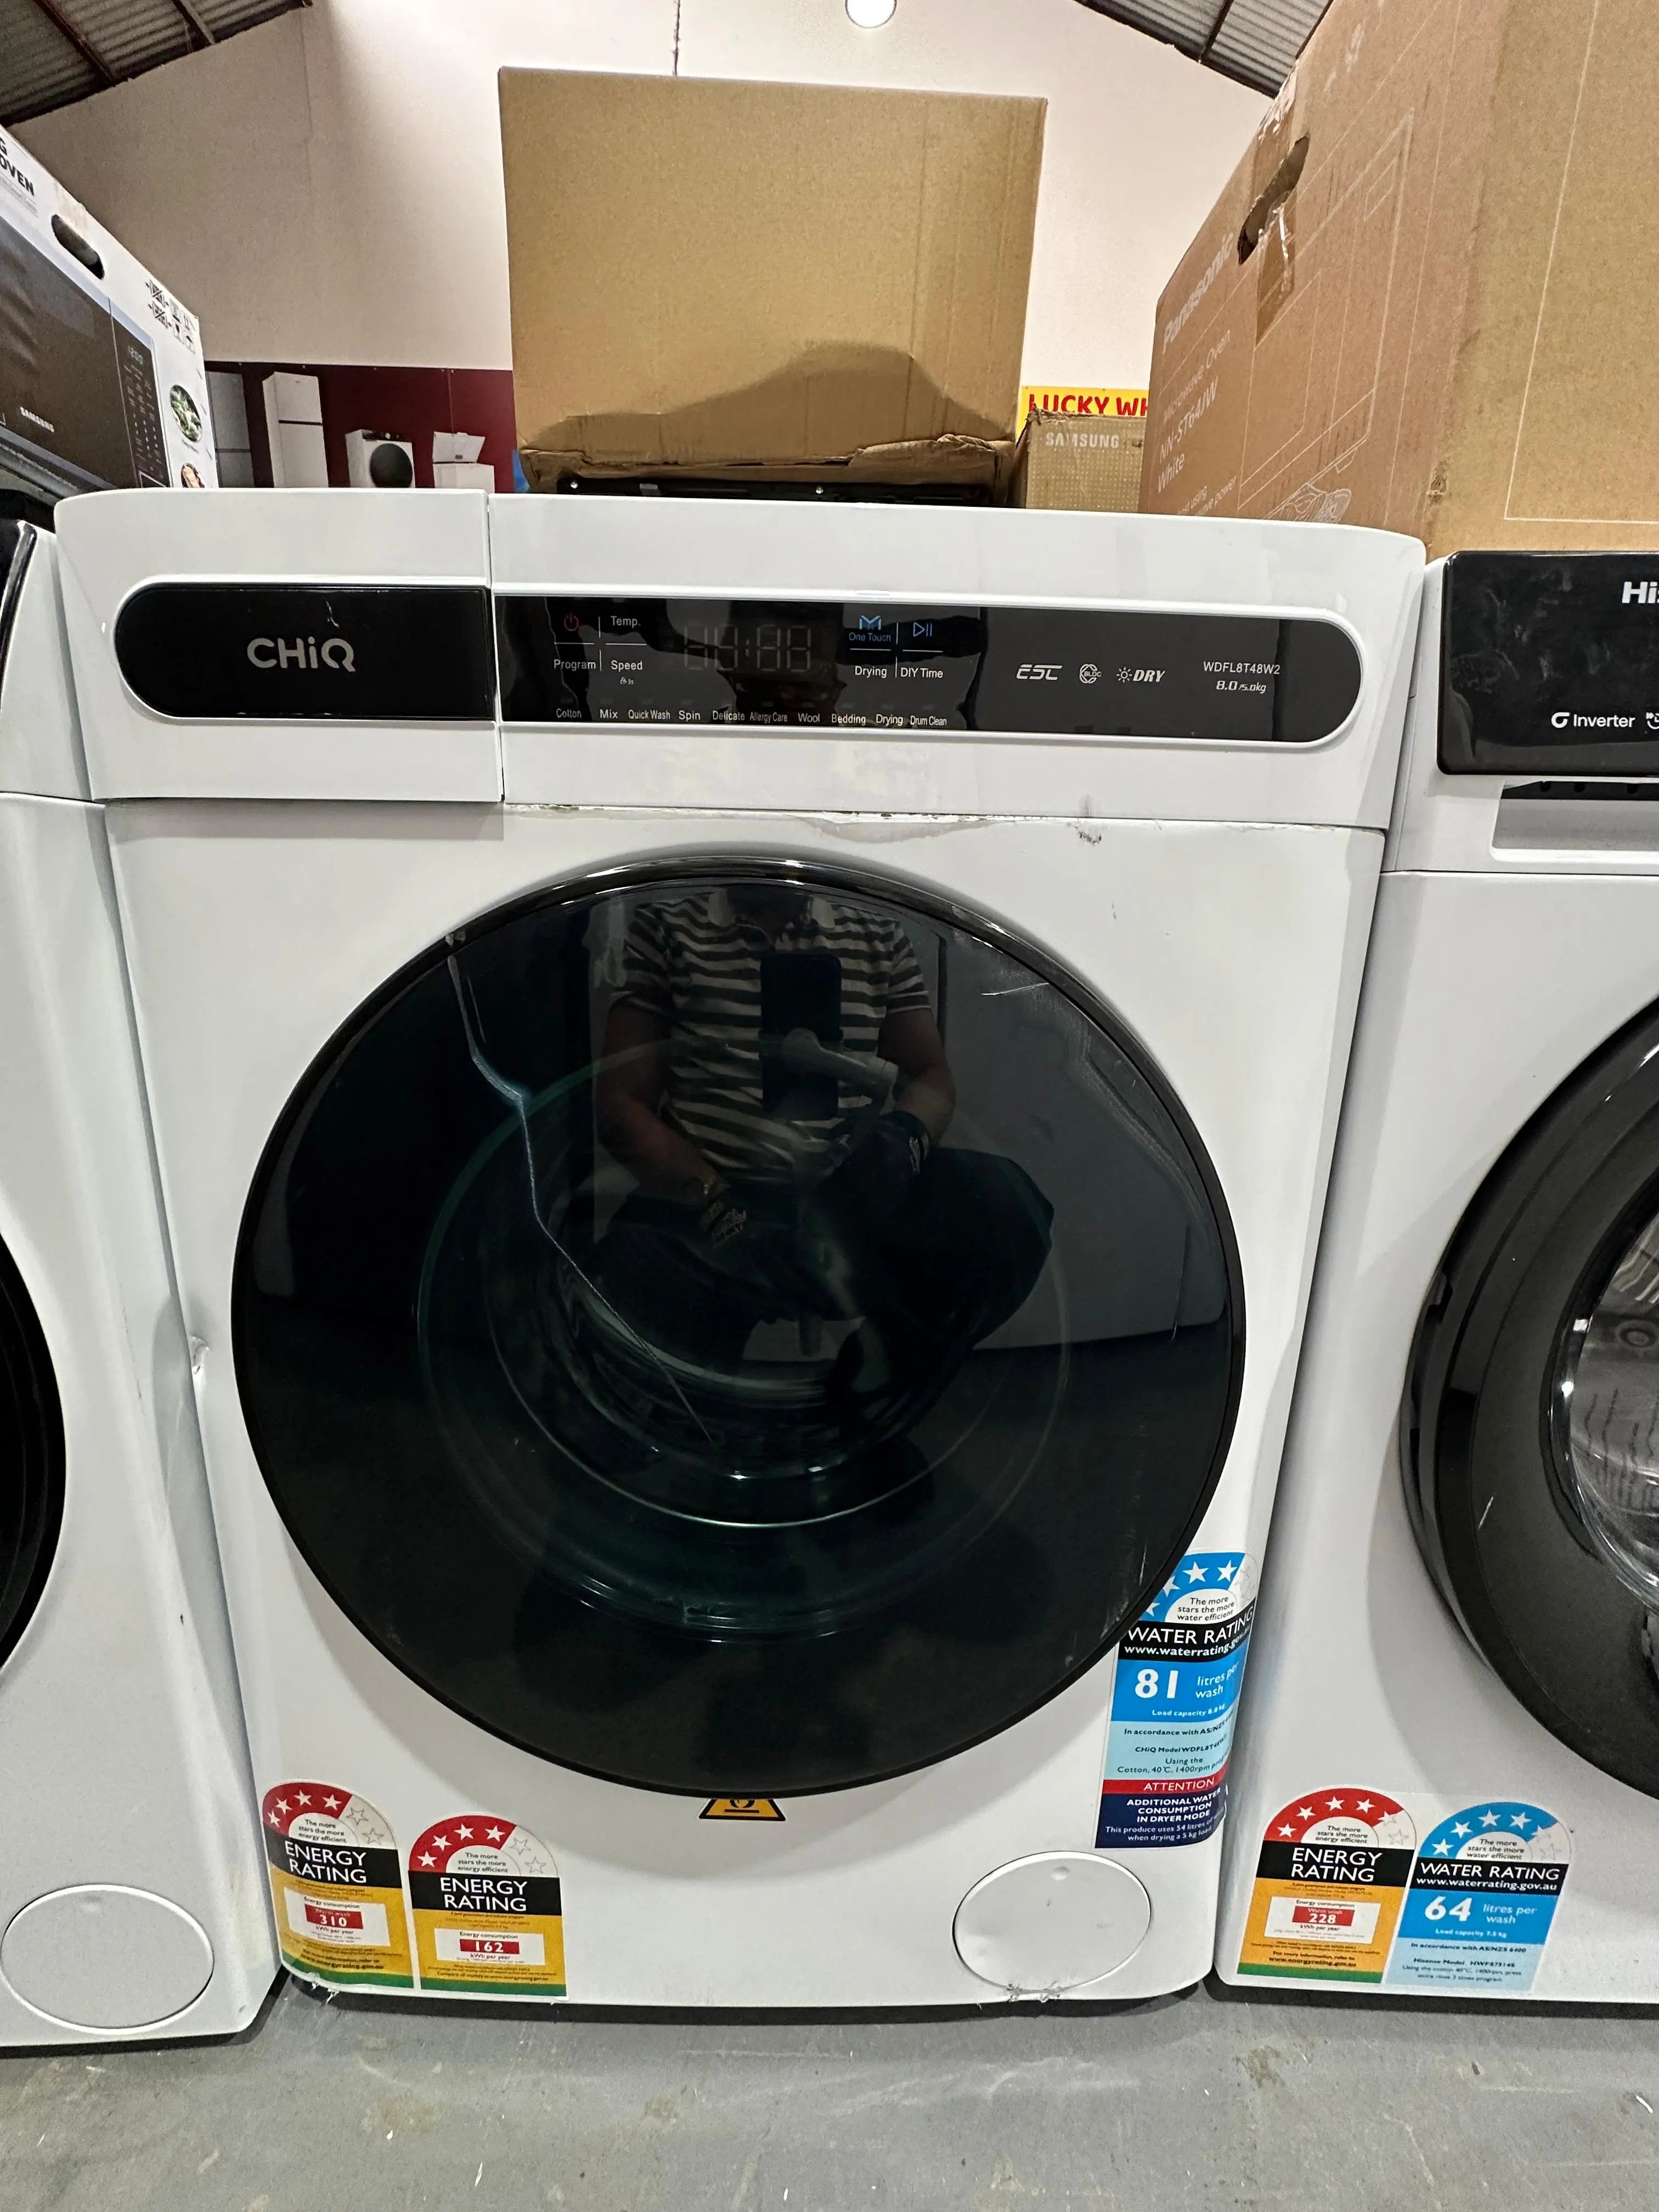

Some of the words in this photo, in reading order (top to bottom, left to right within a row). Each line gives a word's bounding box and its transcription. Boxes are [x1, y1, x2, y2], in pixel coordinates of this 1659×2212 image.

[1162, 231, 1234, 355] Panasonic
[1206, 329, 1231, 369] Oven
[1029, 394, 1110, 414] LUCKY
[1045, 432, 1120, 449] SAMSUNG
[1158, 453, 1186, 493] White
[1622, 581, 1659, 603] Hi
[610, 616, 641, 628] Temp.
[849, 632, 866, 641] One
[868, 633, 891, 642] Touch
[247, 636, 356, 672] CHiQ
[554, 659, 596, 672] Program
[611, 659, 643, 673] Speed
[855, 665, 888, 679] Drying
[1203, 661, 1281, 675] WDFL8T48W2
[900, 667, 918, 678] DIY
[920, 668, 944, 679] Time
[1132, 669, 1166, 682] DRY
[556, 708, 582, 719] Cotton
[600, 709, 618, 719] Mix
[628, 709, 649, 720] Quick
[650, 710, 670, 720] Wash
[679, 710, 701, 721] Spin
[713, 710, 745, 721] Delicate
[749, 712, 771, 723] Allergy
[772, 712, 788, 723] Care
[798, 712, 820, 723] Wool
[831, 714, 866, 726] Bedding
[876, 714, 904, 726] Drying
[910, 715, 928, 726] Drum
[928, 715, 947, 726] Clean
[1573, 714, 1635, 727] Inverter
[1208, 1596, 1229, 1605] more
[1216, 1601, 1234, 1612] more
[1204, 1609, 1233, 1621] efficient
[1128, 1627, 1198, 1644] WATER
[1204, 1606, 1253, 1644] RATING
[1197, 1672, 1225, 1686] litres
[1195, 1685, 1223, 1699] wash
[1173, 1709, 1206, 1718] capacity
[1165, 1757, 1188, 1765] Using
[1143, 1777, 1215, 1792] ATTENTION
[1192, 1787, 1221, 1803] WATER
[1138, 1802, 1212, 1815] CONSUMPTION
[1183, 1809, 1210, 1821] MODE
[304, 1819, 317, 1827] The
[298, 1833, 320, 1841] energy
[1150, 1834, 1175, 1842] drying
[285, 1840, 366, 1866] ENERGY
[1292, 1847, 1383, 1866] ENERGY
[289, 1858, 367, 1883] RATING
[1291, 1864, 1375, 1882] RATING
[1420, 1862, 1482, 1877] WATER
[1489, 1865, 1560, 1881] RATING
[440, 1877, 528, 1895] ENERGY
[1416, 1877, 1558, 1891] www.waterrating.gov.au
[444, 1894, 527, 1911] RATING
[1424, 1895, 1473, 1922] 64
[1483, 1903, 1513, 1914] litres
[1516, 1907, 1538, 1916] per
[319, 1915, 347, 1927] 310
[1308, 1913, 1336, 1924] 228
[1486, 1914, 1516, 1924] wash
[475, 1940, 504, 1953] 162
